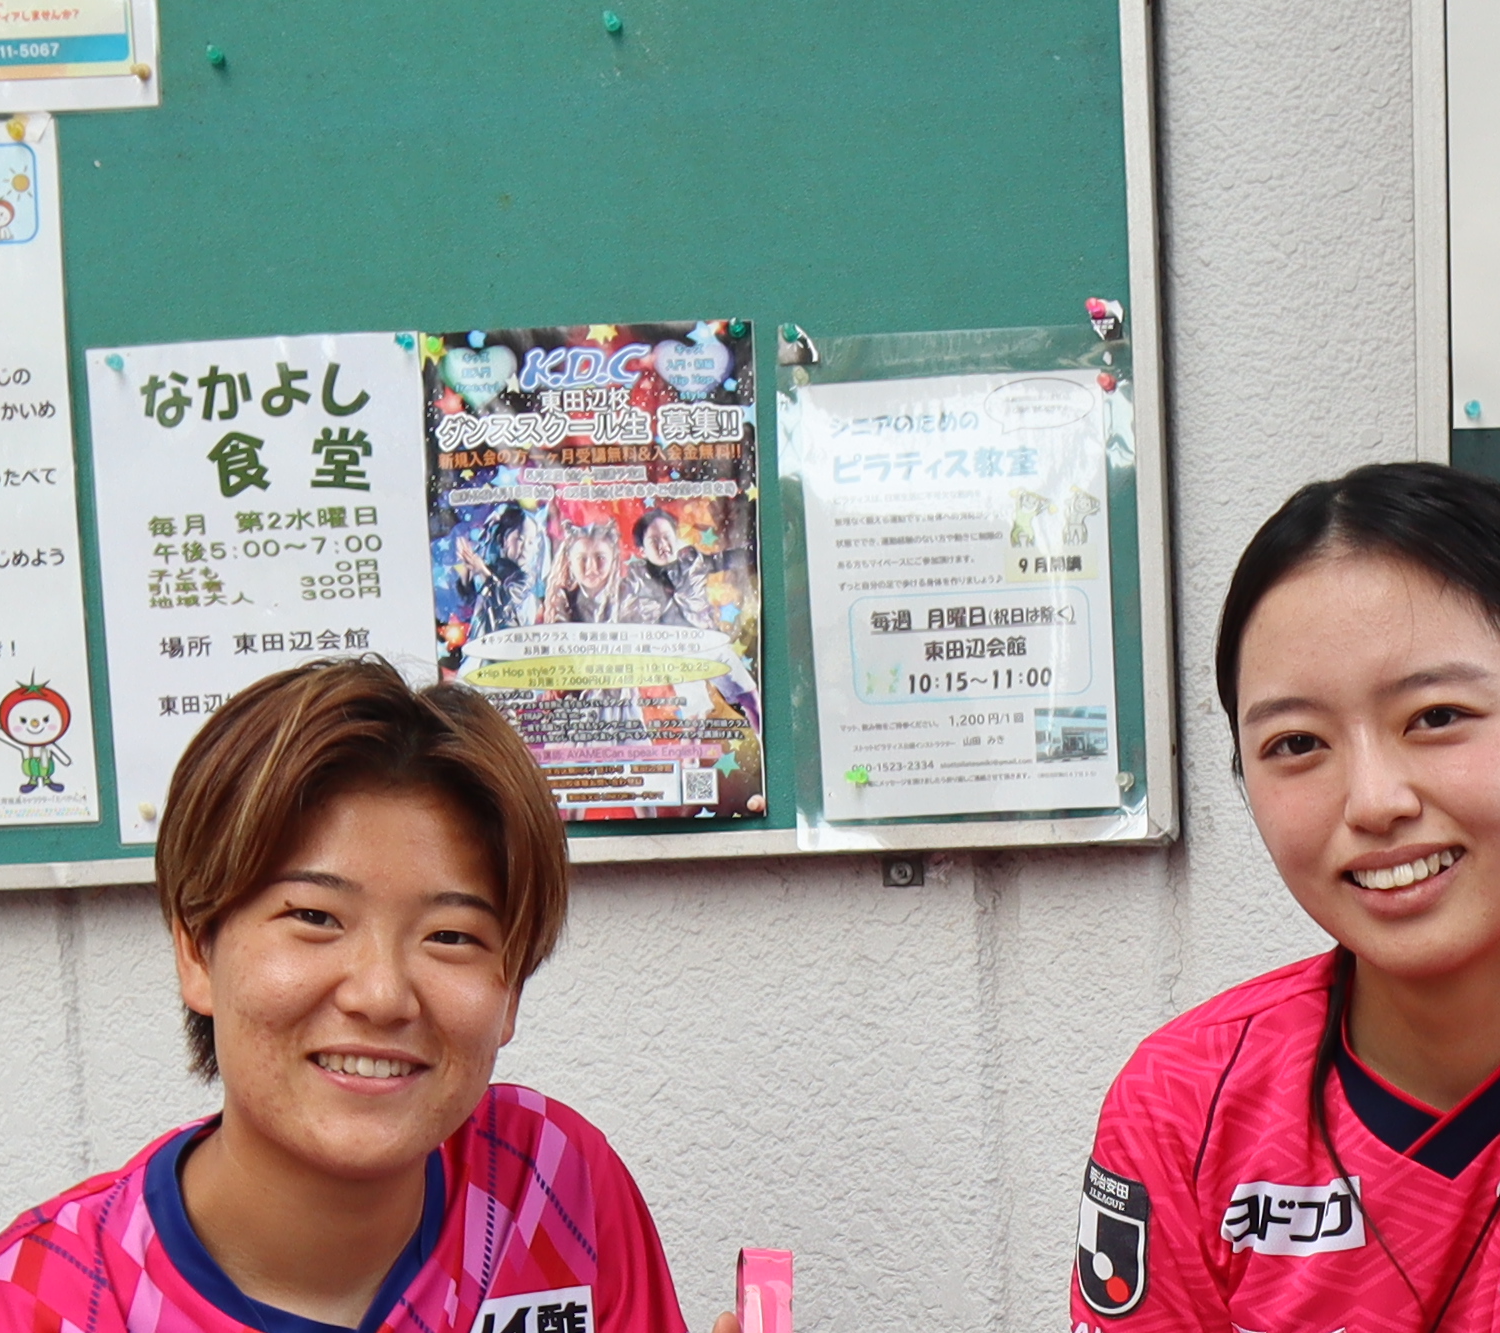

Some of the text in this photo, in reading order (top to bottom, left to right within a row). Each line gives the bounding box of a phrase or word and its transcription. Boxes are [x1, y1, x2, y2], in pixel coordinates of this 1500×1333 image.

[520, 344, 650, 392] K.D.C
[139, 362, 372, 428] なかよし
[540, 388, 632, 413] 東田辺校
[439, 413, 651, 449] ダンススクール生
[829, 411, 979, 437] シニアのための
[832, 446, 1040, 484] ピラティス教室
[148, 506, 379, 537] 毎月 第2水曜日
[148, 567, 219, 582] 子ども
[300, 573, 380, 587] 300円
[149, 585, 381, 608] 地域大人 300円
[871, 610, 911, 632] 毎週
[160, 628, 371, 659] 場所 東田辺会館
[924, 636, 1027, 660] 東田辺会館
